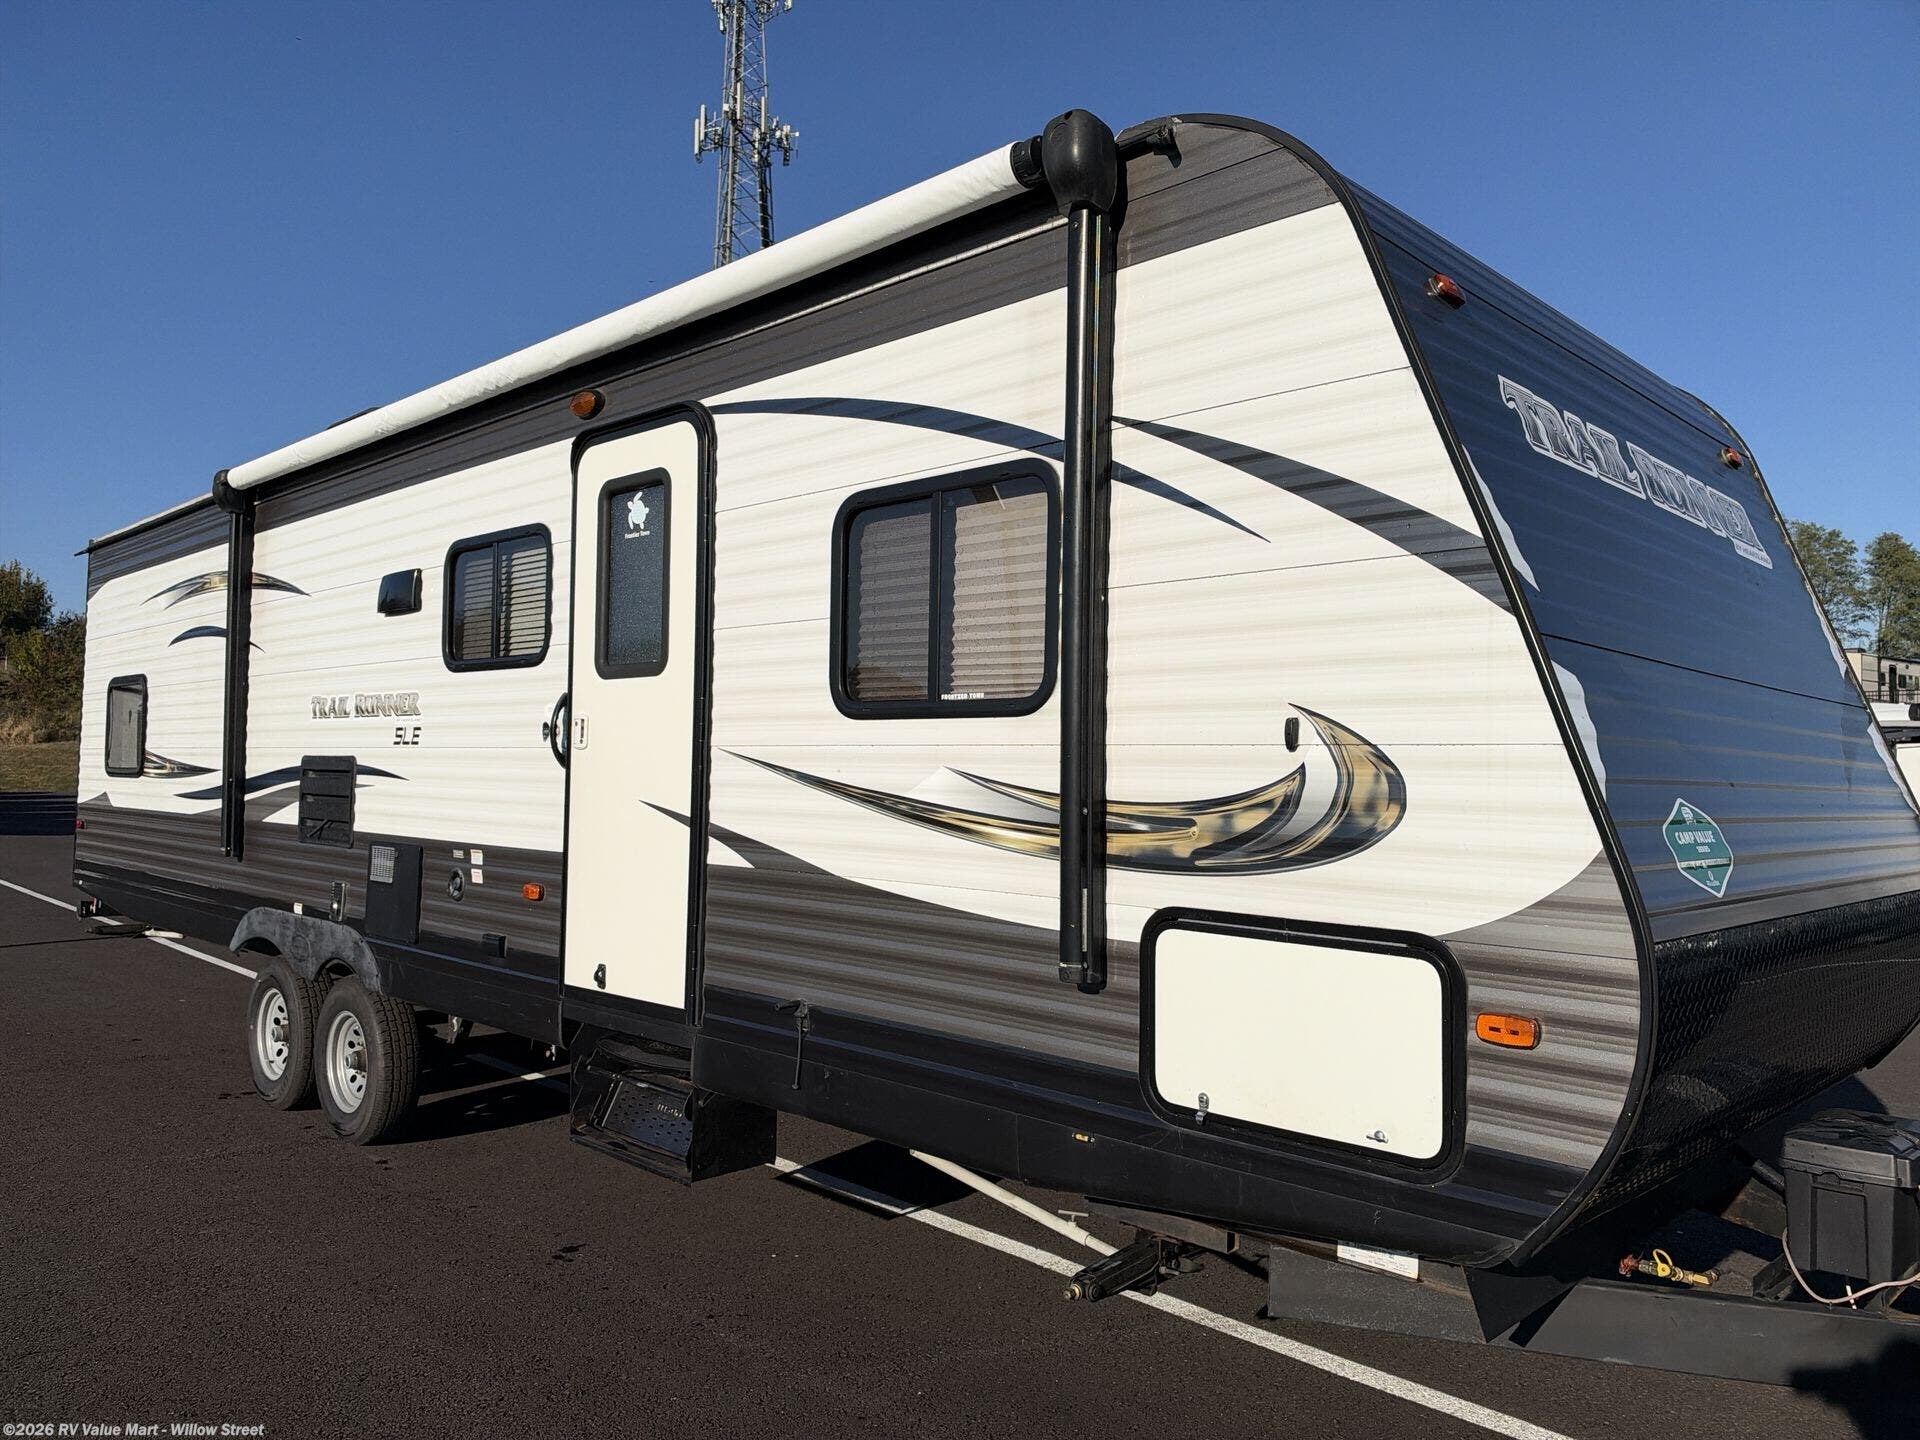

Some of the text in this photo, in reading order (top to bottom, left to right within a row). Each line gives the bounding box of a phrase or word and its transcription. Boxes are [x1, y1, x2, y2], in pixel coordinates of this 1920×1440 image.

[1498, 374, 1765, 553] TRAIL RUNNER
[311, 692, 421, 719] TRAIL RUNNER
[393, 726, 422, 745] SLE
[1675, 830, 1717, 845] CAMP VALUE
